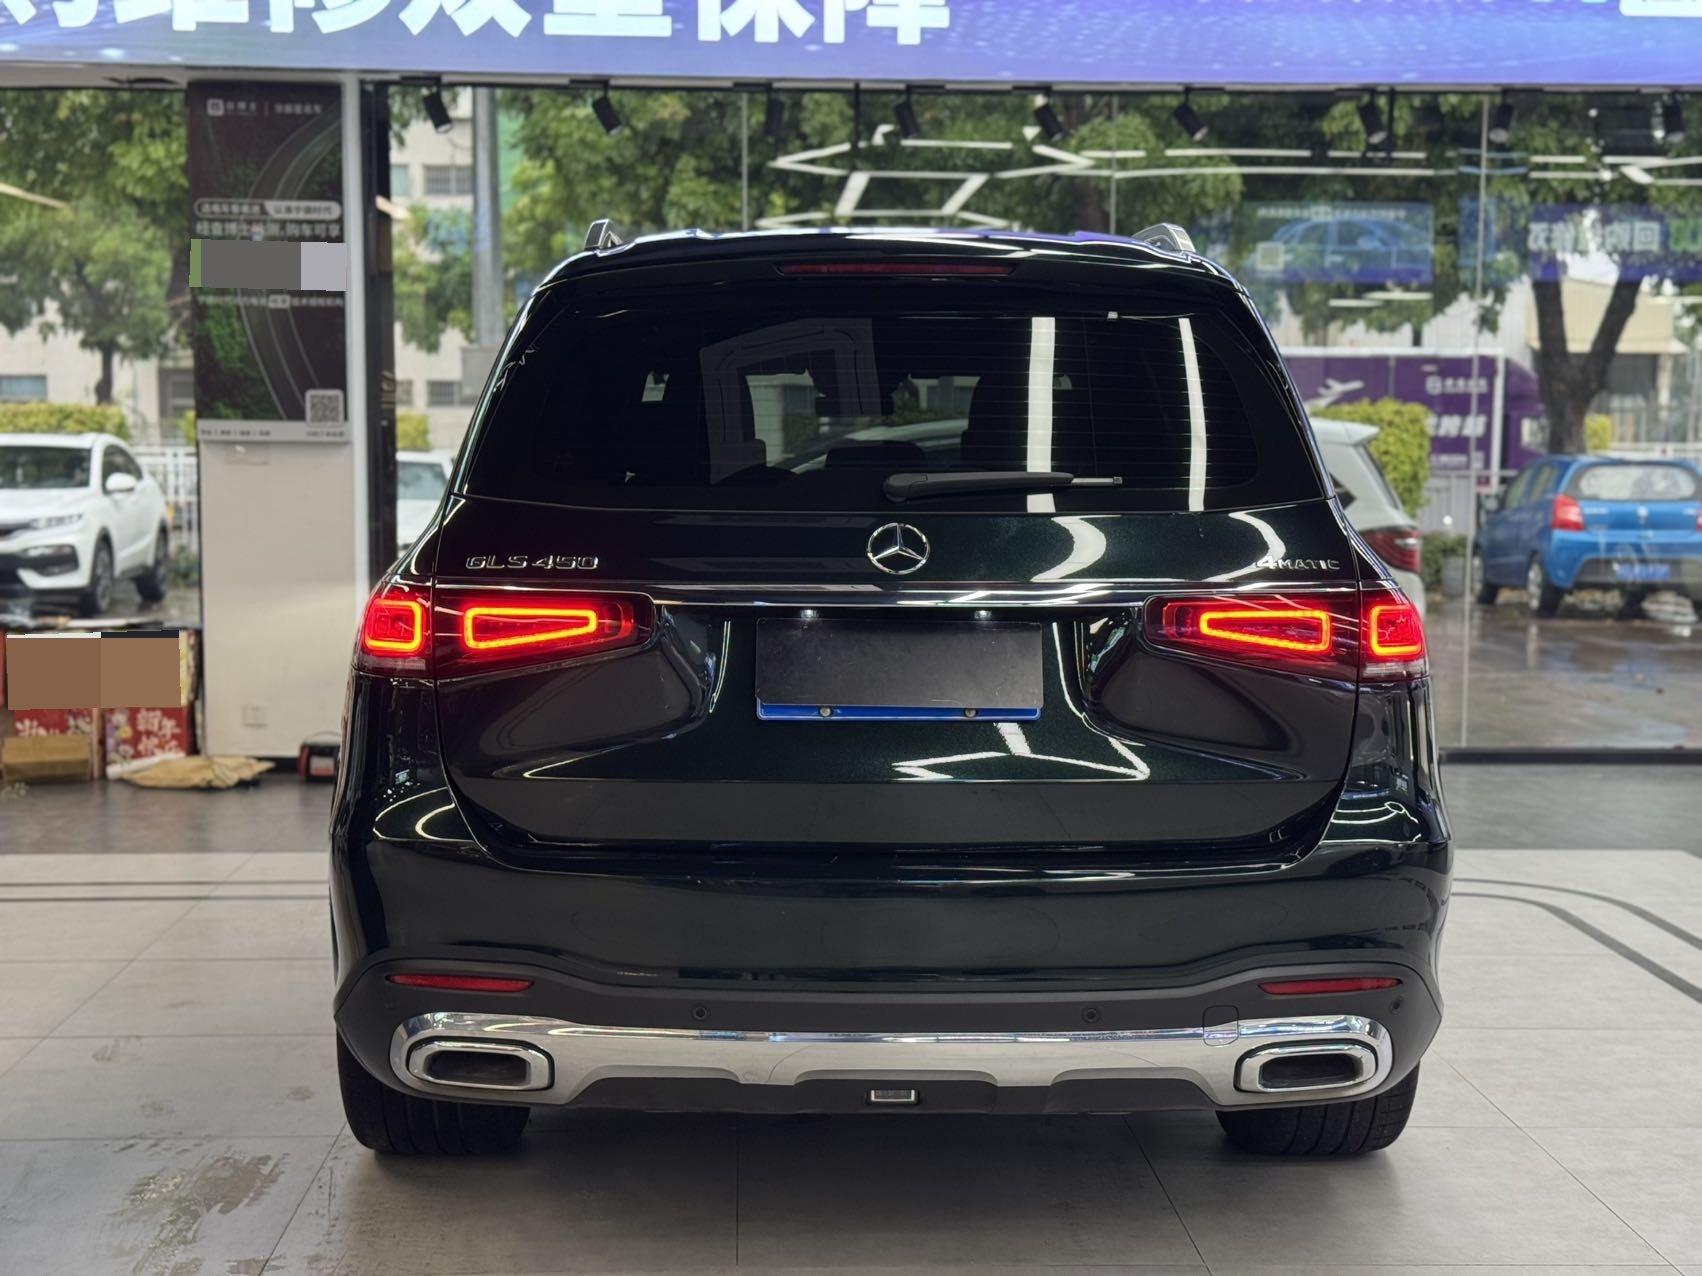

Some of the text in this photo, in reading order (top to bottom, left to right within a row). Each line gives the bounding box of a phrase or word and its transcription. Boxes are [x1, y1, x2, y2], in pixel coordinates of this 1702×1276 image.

[465, 555, 599, 570] GLS 450
[1256, 556, 1341, 570] 4MATIC
